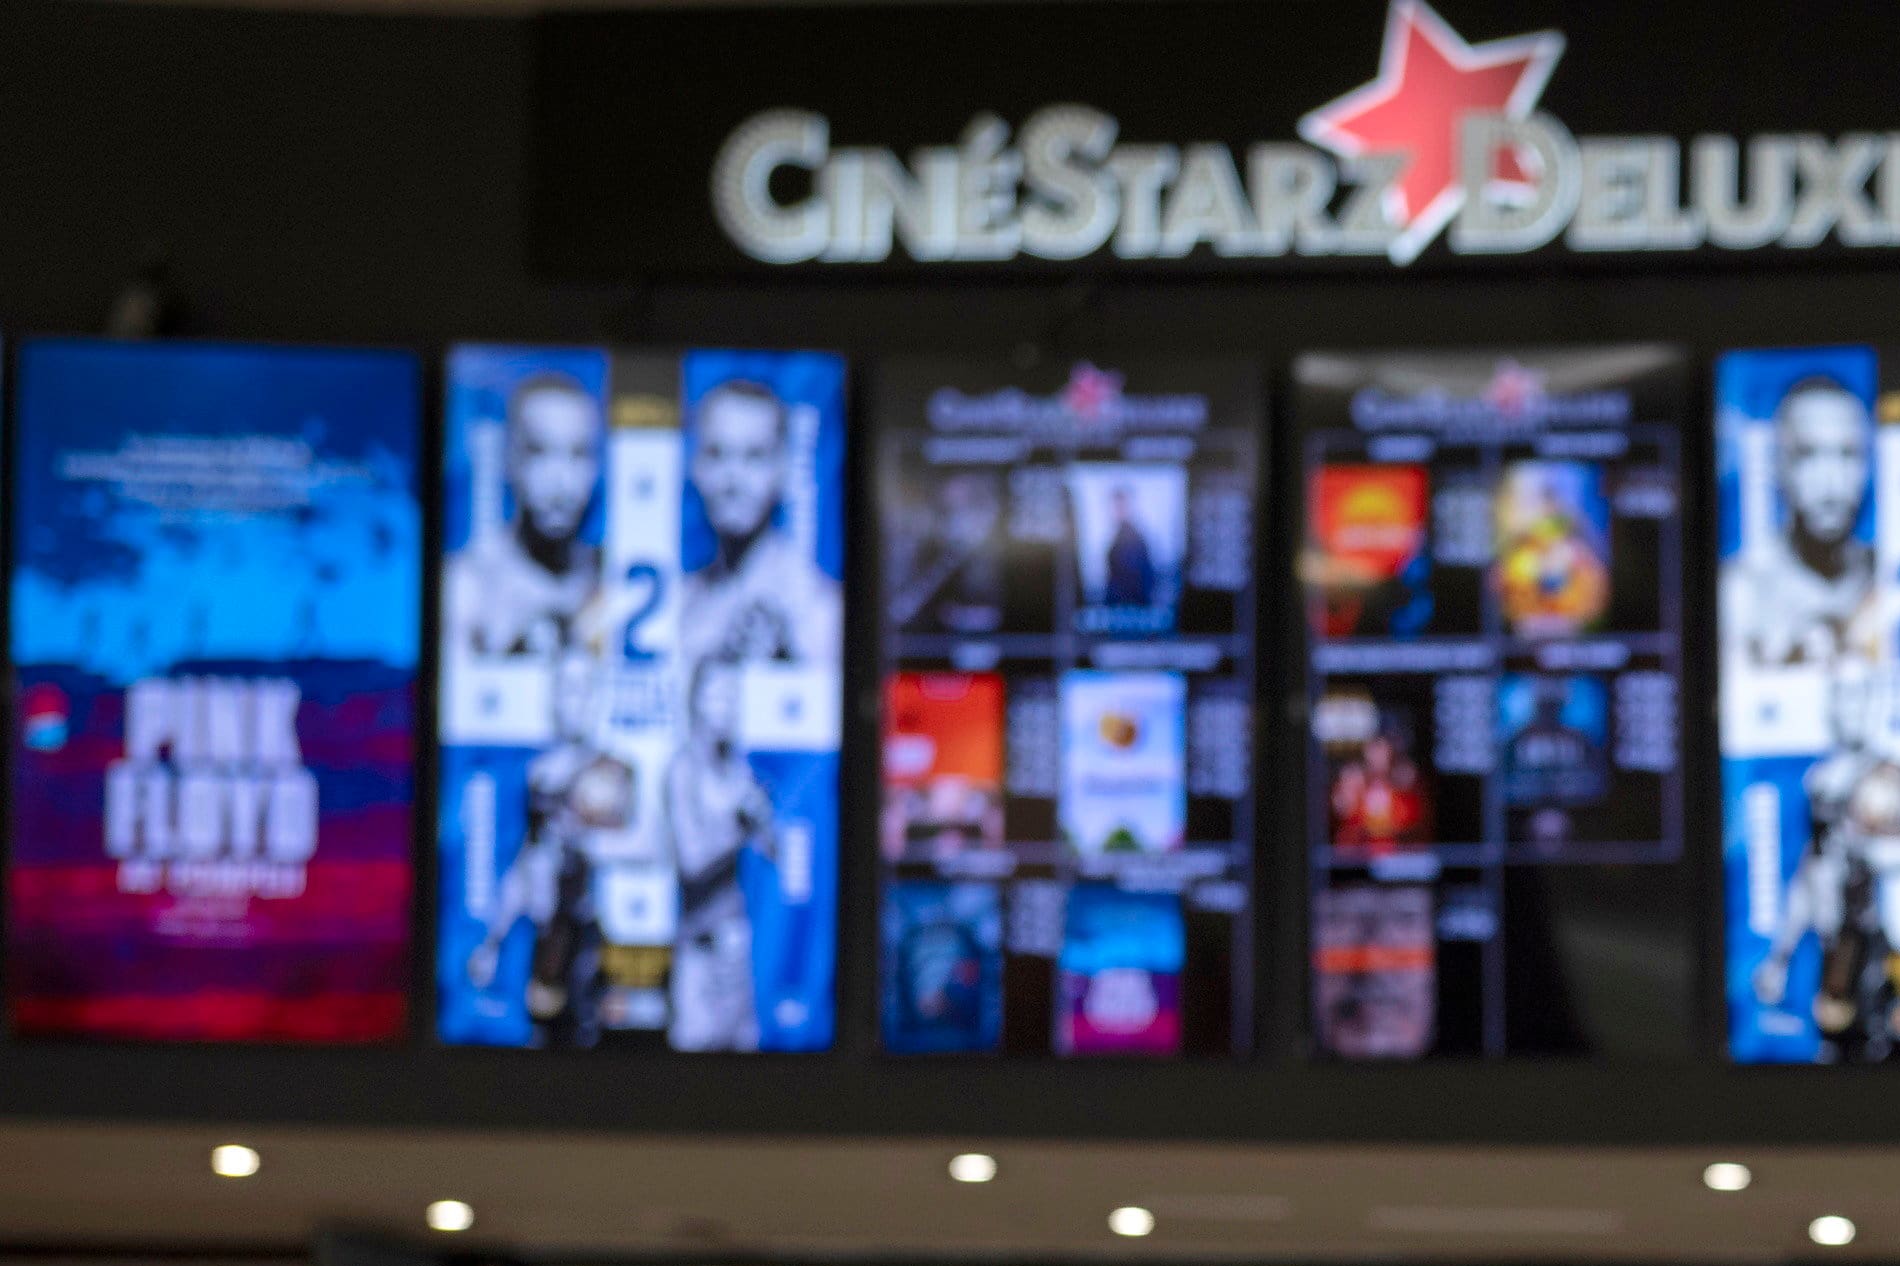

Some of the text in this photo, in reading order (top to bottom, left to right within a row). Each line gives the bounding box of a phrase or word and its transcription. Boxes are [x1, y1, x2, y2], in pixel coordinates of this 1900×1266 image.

[623, 560, 665, 663] 2
[123, 673, 304, 764] PINK
[102, 761, 320, 862] FLOYD
